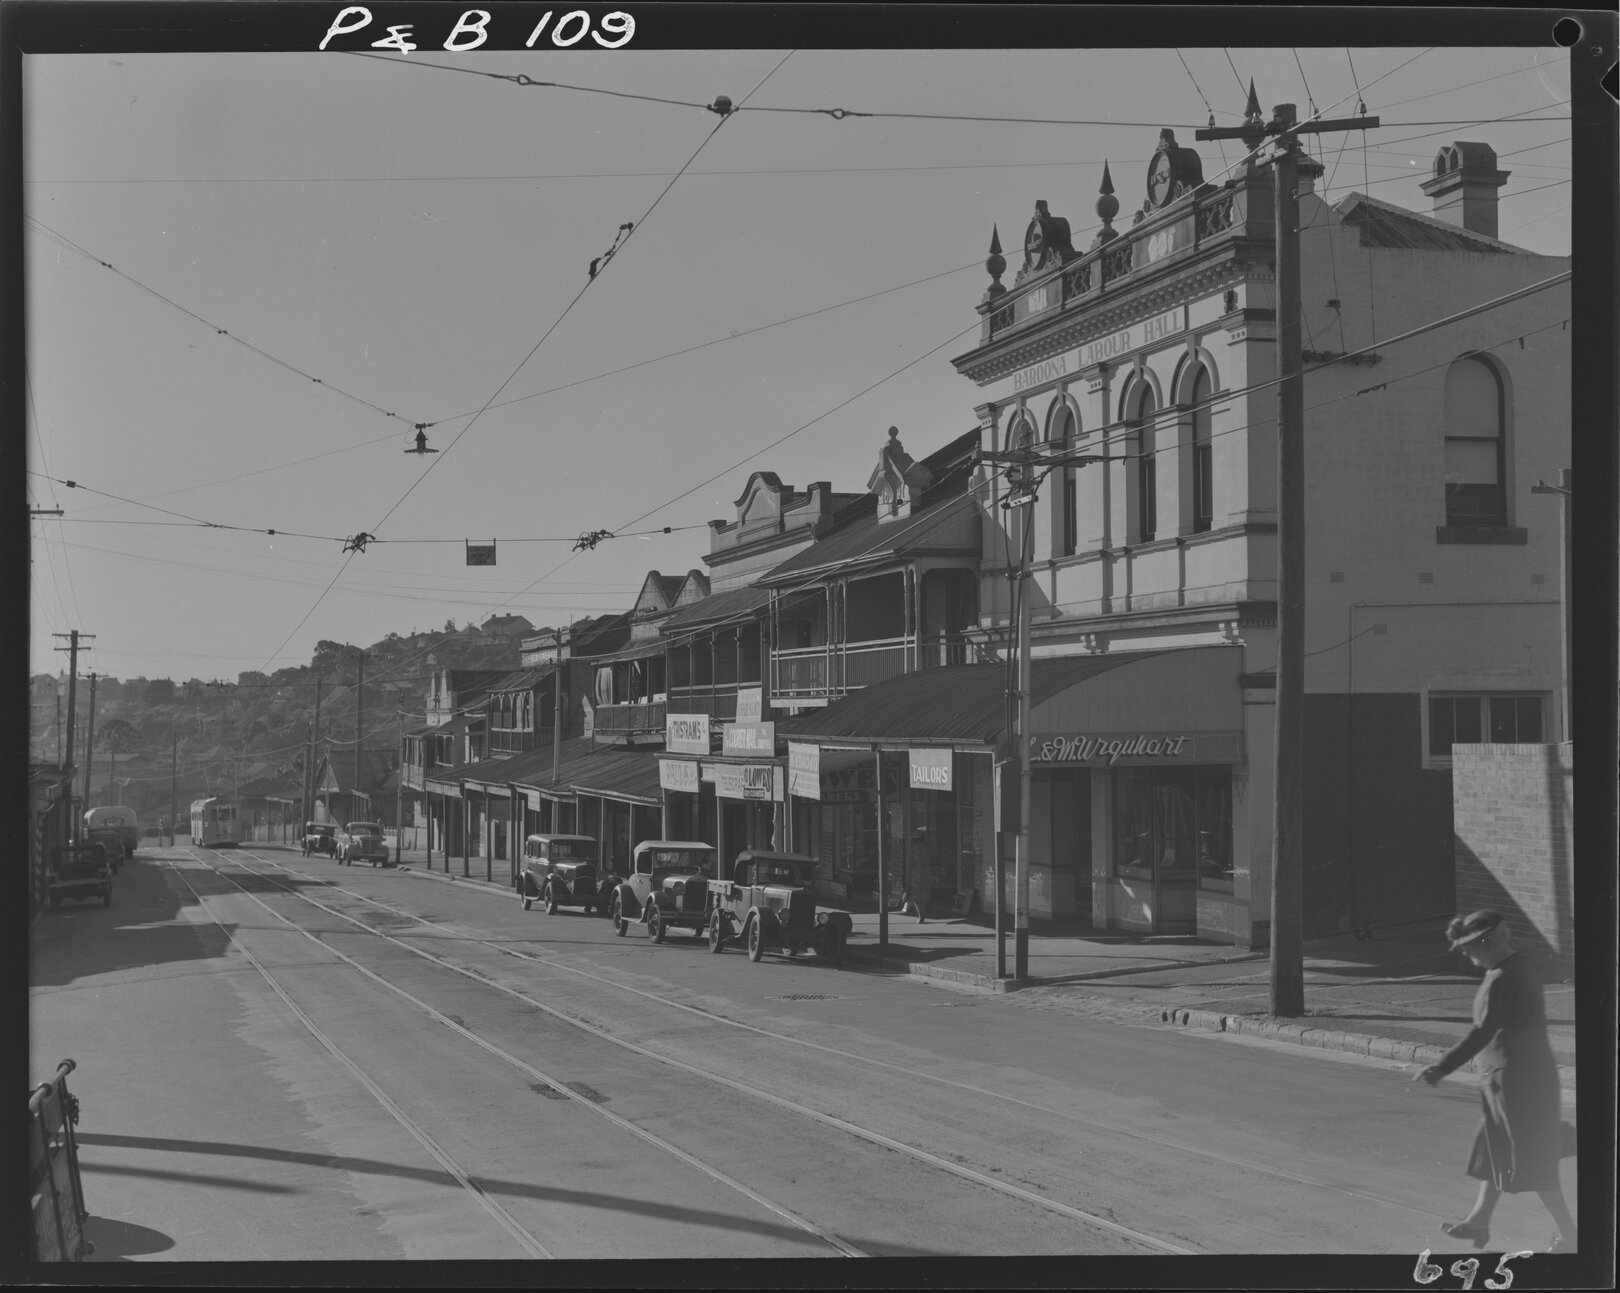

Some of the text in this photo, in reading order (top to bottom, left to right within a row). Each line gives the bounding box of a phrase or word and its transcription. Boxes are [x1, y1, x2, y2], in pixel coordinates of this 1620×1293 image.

[1014, 310, 1183, 391] BAROONA LABOUR HALL
[911, 763, 948, 784] TAILORS
